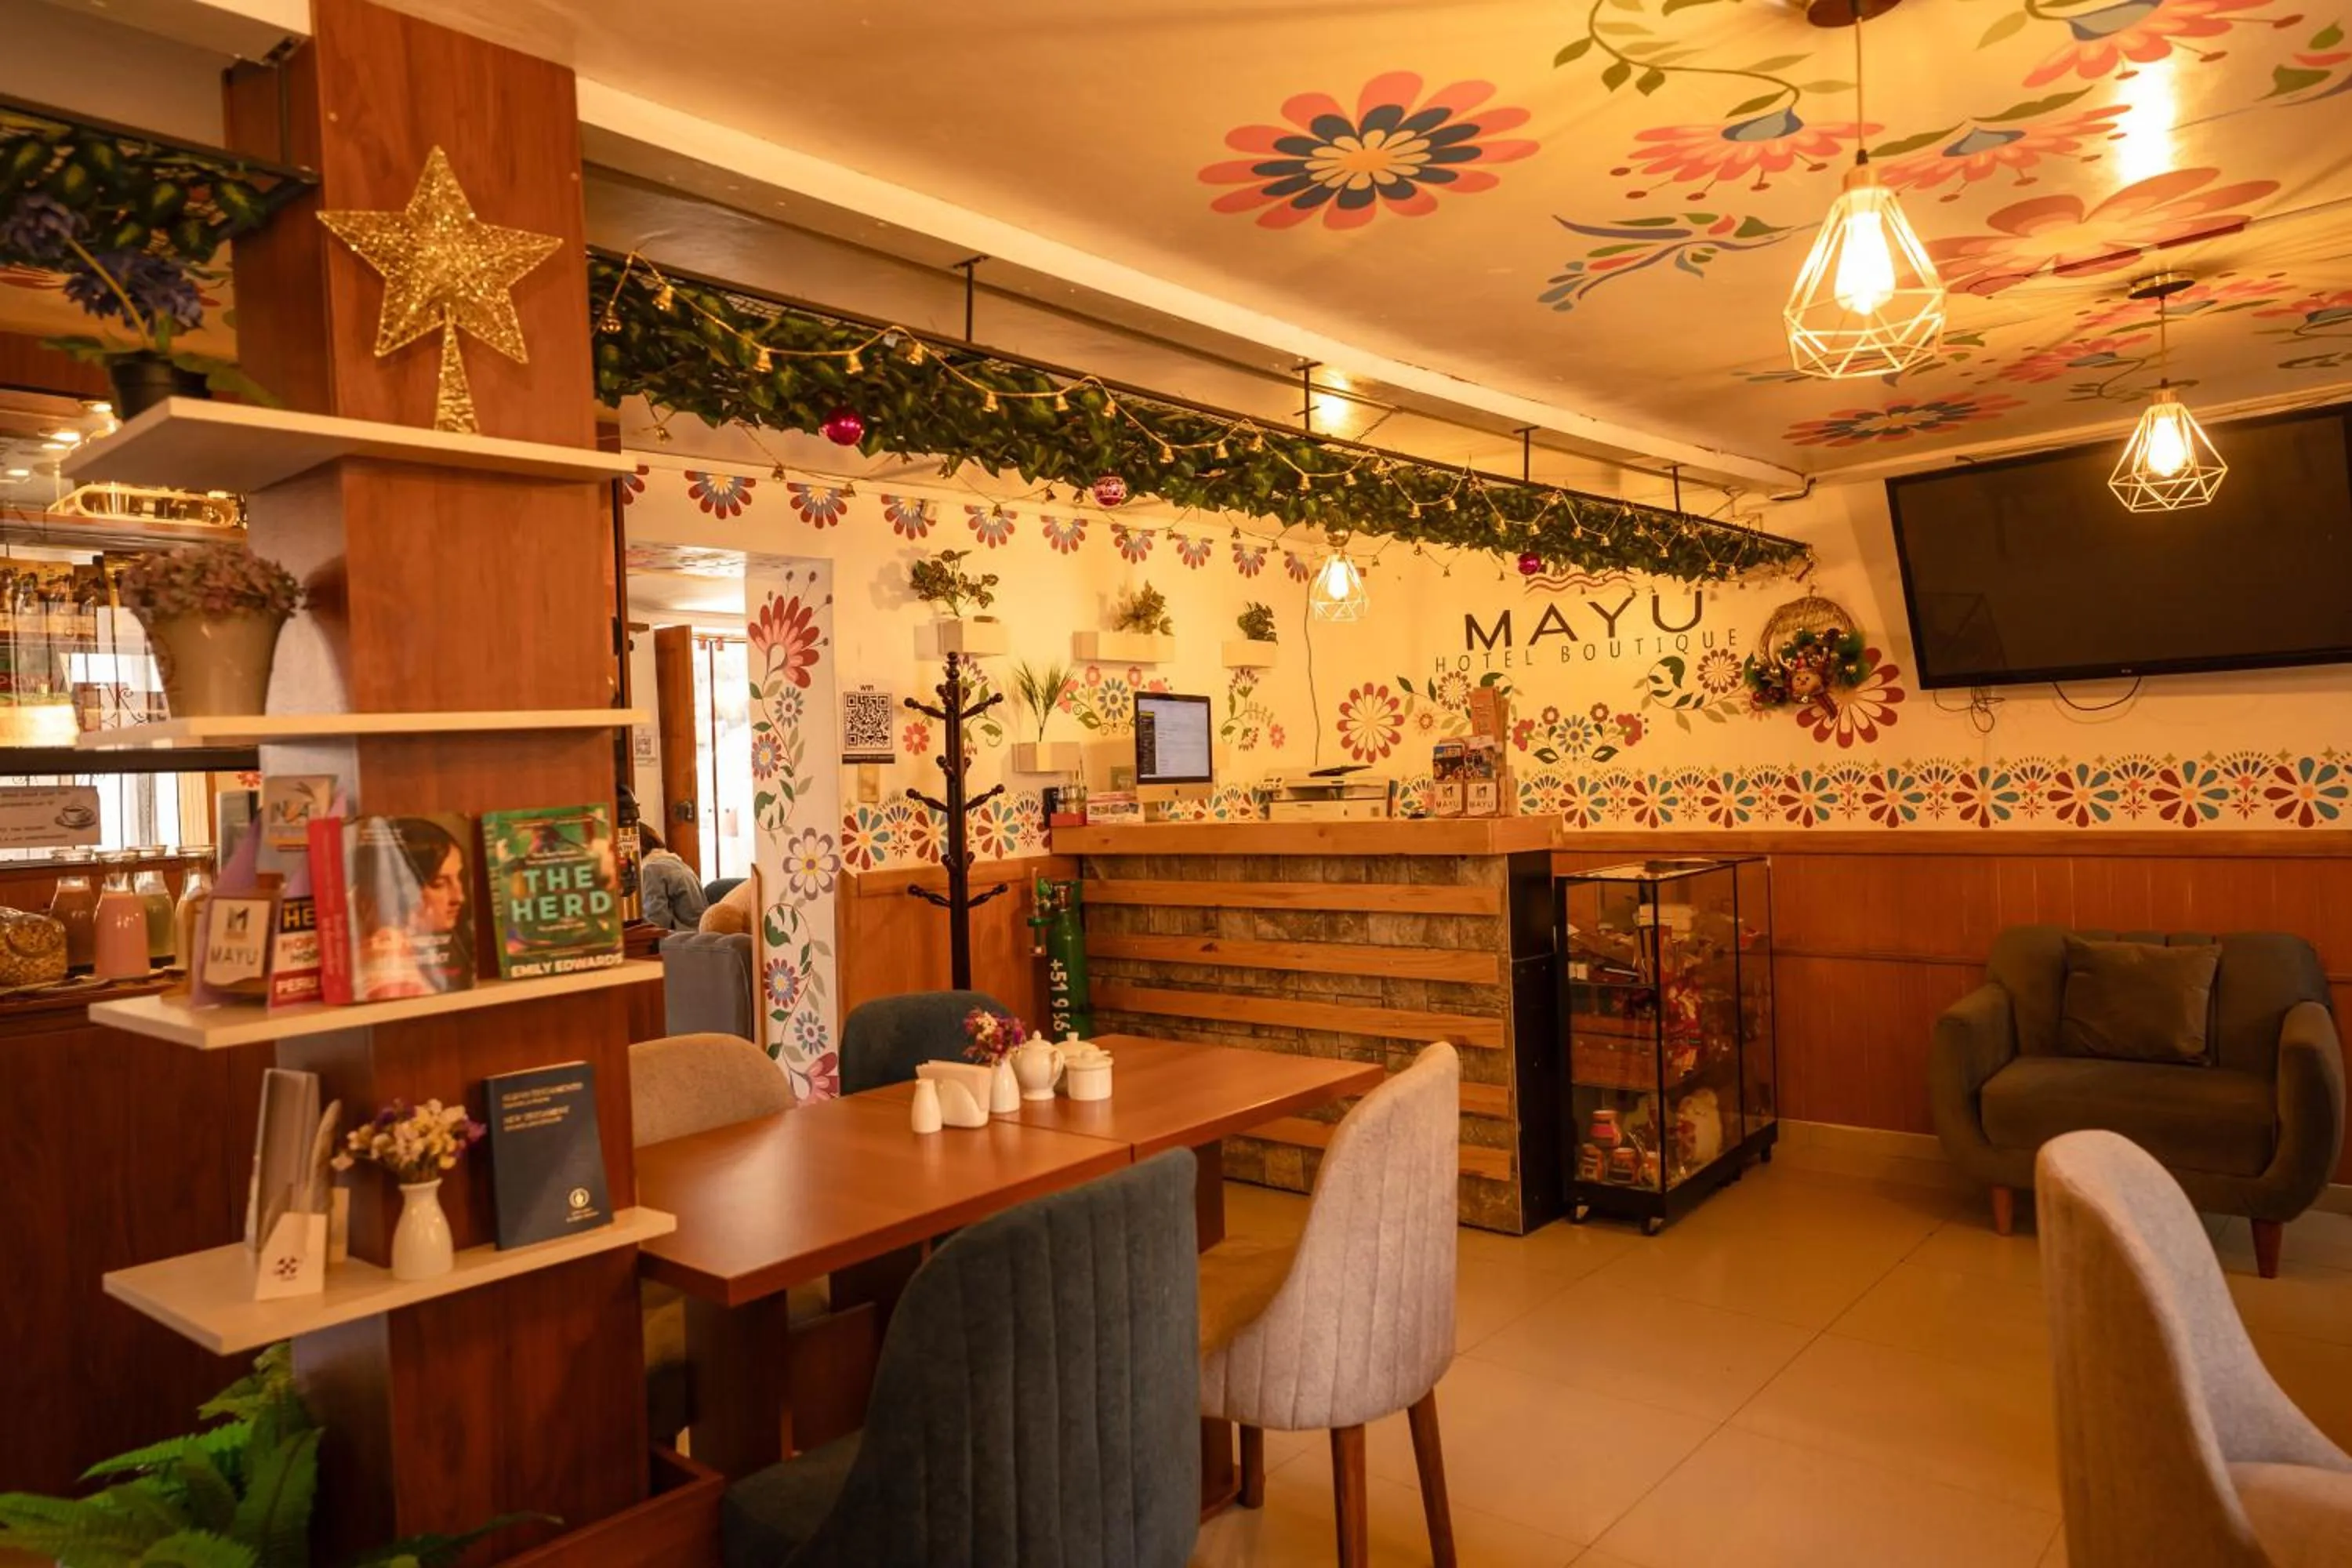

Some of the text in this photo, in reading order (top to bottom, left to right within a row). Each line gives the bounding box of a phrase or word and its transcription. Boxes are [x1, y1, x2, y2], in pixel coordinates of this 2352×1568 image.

[1465, 590, 1703, 652] MAYU
[1435, 628, 1738, 673] HOTEL BOUTIQUE
[522, 865, 594, 894] THE
[511, 889, 612, 923] HERD
[209, 945, 260, 966] MAYU
[511, 961, 552, 978] EMILY
[554, 952, 625, 974] EDWARDS
